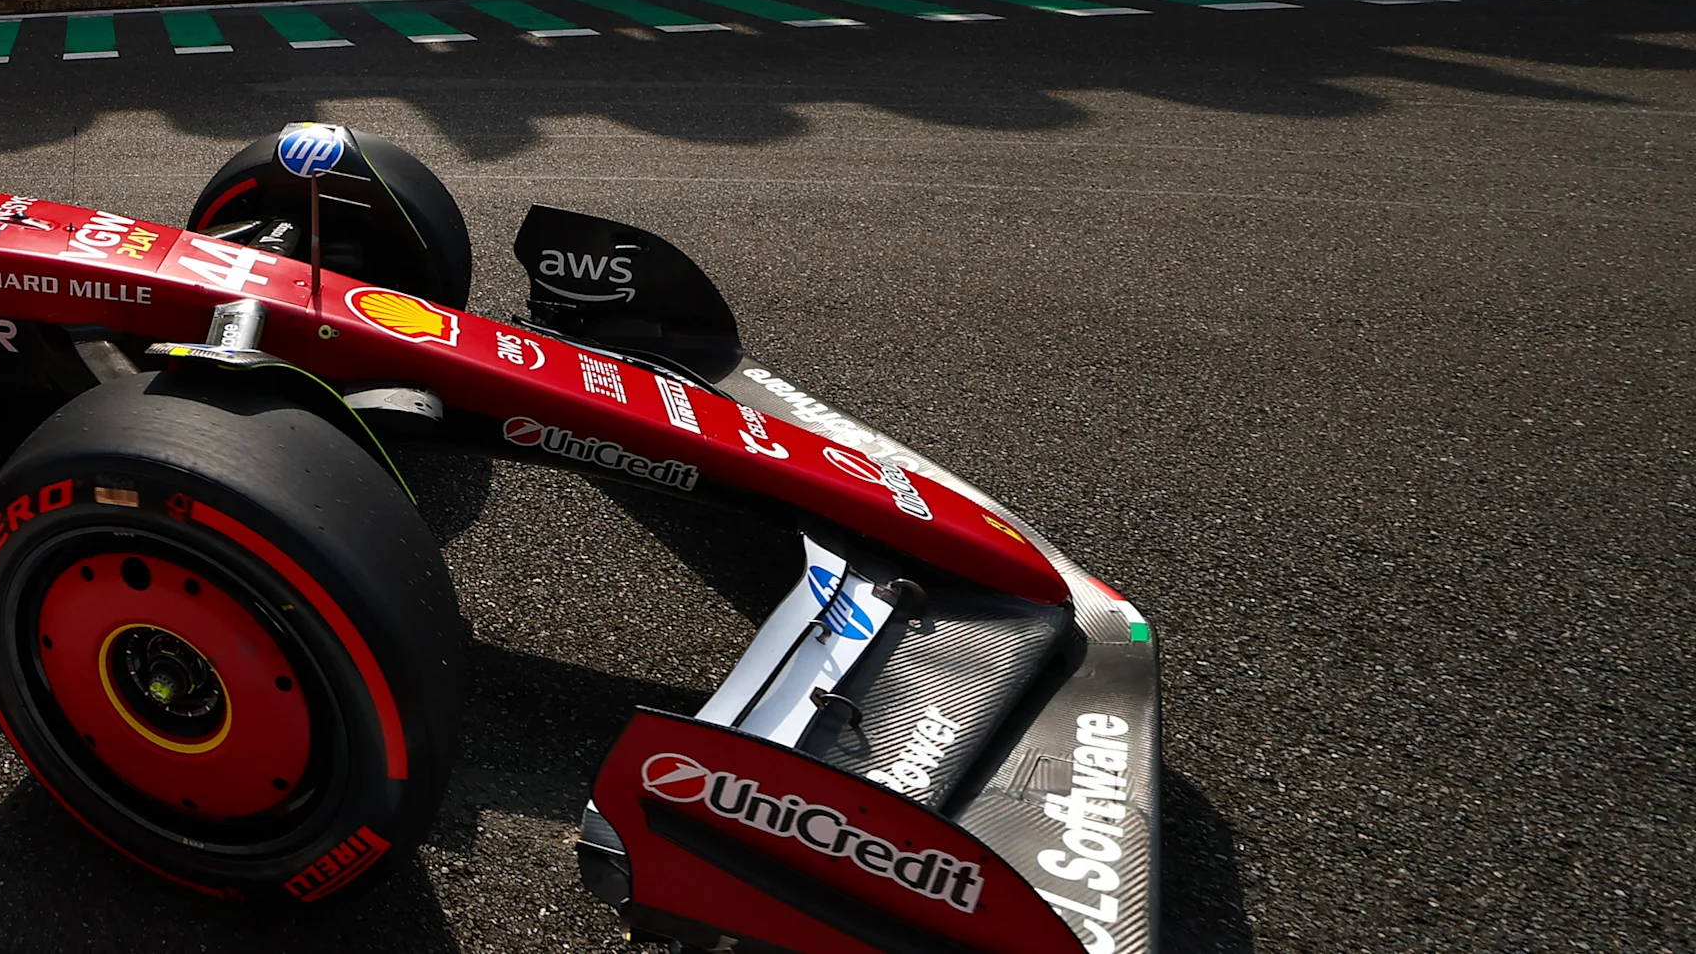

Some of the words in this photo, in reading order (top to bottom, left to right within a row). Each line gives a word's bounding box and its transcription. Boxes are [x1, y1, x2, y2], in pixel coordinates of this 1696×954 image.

[283, 130, 340, 176] hp
[58, 210, 136, 259] VGW
[116, 227, 159, 259] PLAY
[178, 238, 278, 292] 44
[538, 248, 634, 286] aws
[69, 279, 152, 305] MILLE
[496, 331, 524, 365] aws
[654, 375, 702, 435] PIRELLI
[542, 425, 699, 491] UniCredit
[1037, 713, 1130, 891] Software
[284, 825, 392, 903] PIRELLI
[705, 773, 985, 914] UniCredit
